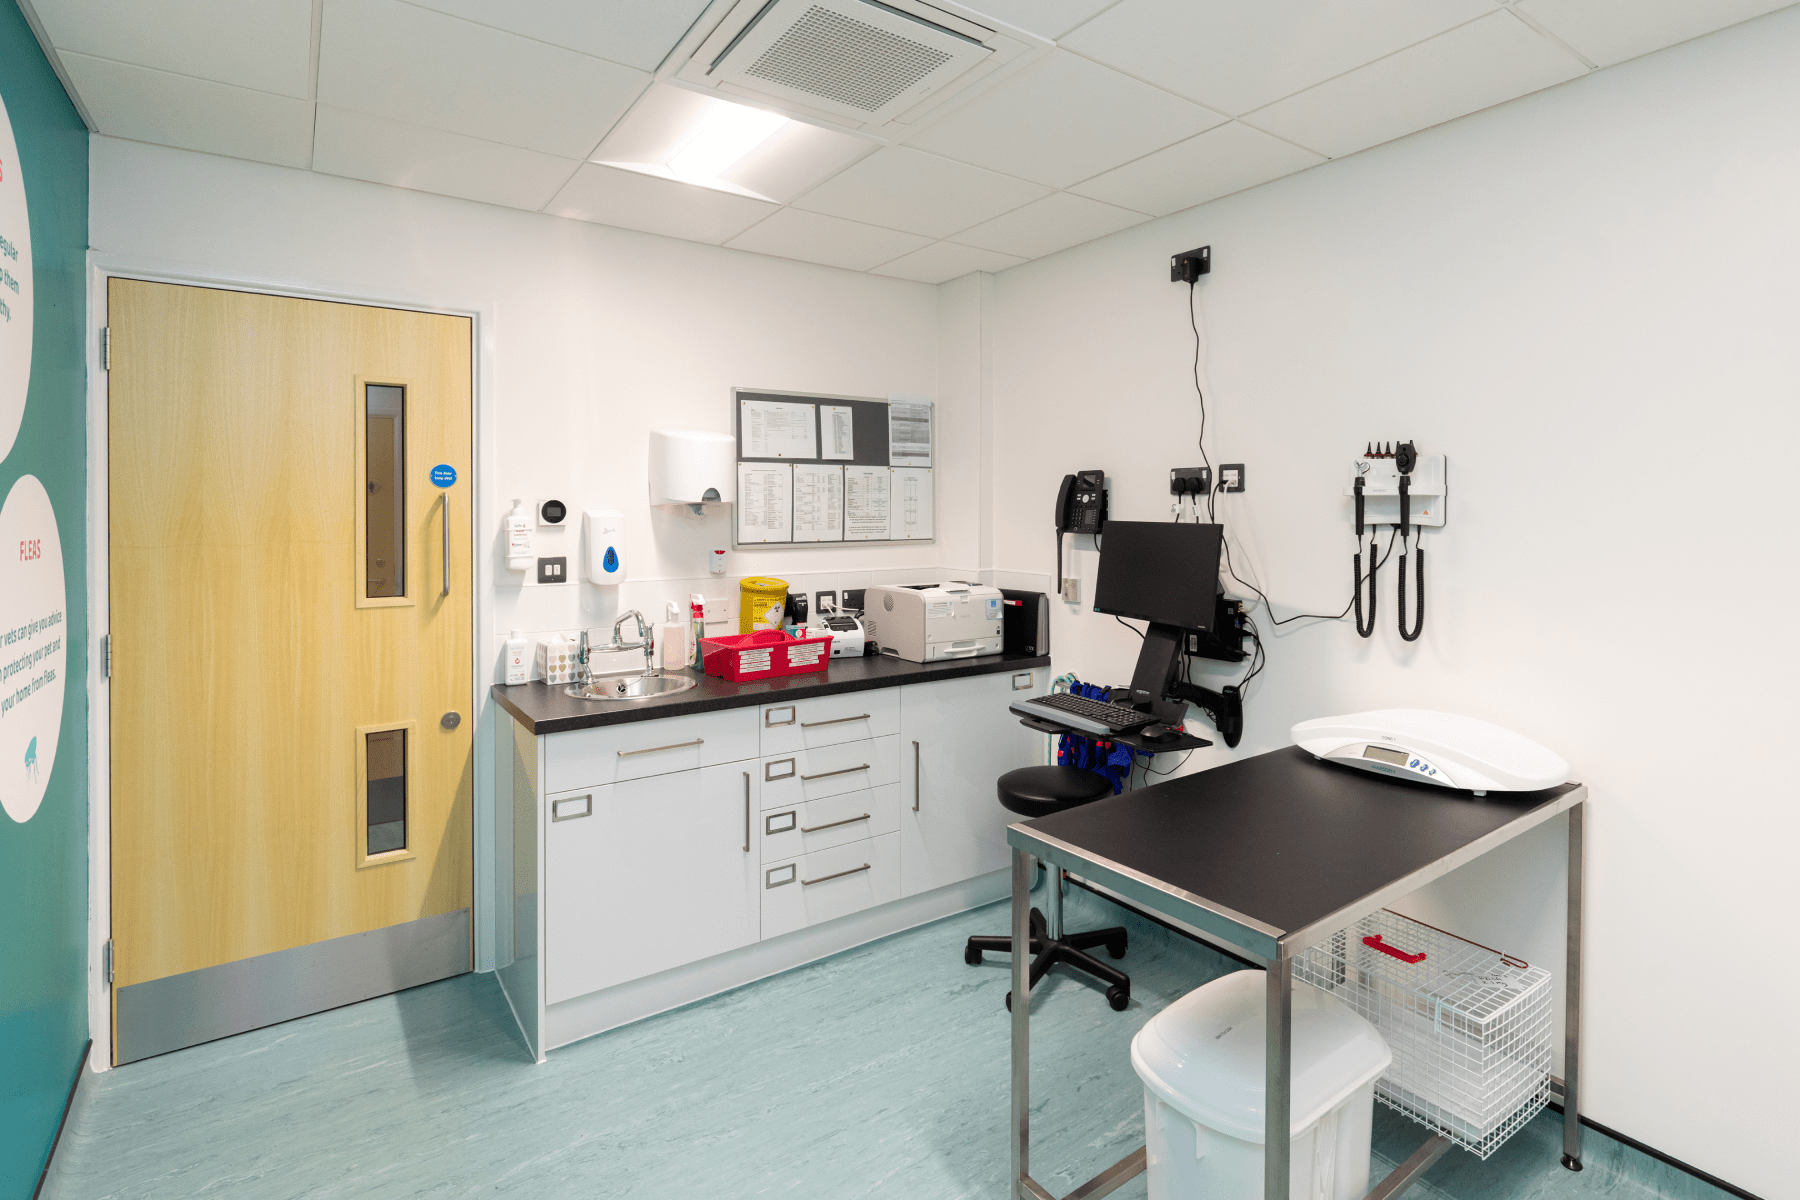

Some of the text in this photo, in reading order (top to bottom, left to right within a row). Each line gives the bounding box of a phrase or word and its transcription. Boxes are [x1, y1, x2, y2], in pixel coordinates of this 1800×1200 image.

[4, 268, 19, 296] them
[19, 538, 41, 562] FLEAS
[4, 628, 17, 646] vets
[17, 625, 28, 641] can
[28, 619, 38, 641] give
[39, 617, 48, 635] you
[48, 609, 62, 627] advice
[3, 652, 32, 684] protecting
[32, 646, 44, 667] your
[44, 640, 52, 661] pet
[52, 635, 61, 653] and
[0, 694, 15, 718] your
[15, 683, 31, 704] home
[31, 677, 44, 693] from
[1371, 764, 1396, 774] MARSDEN
